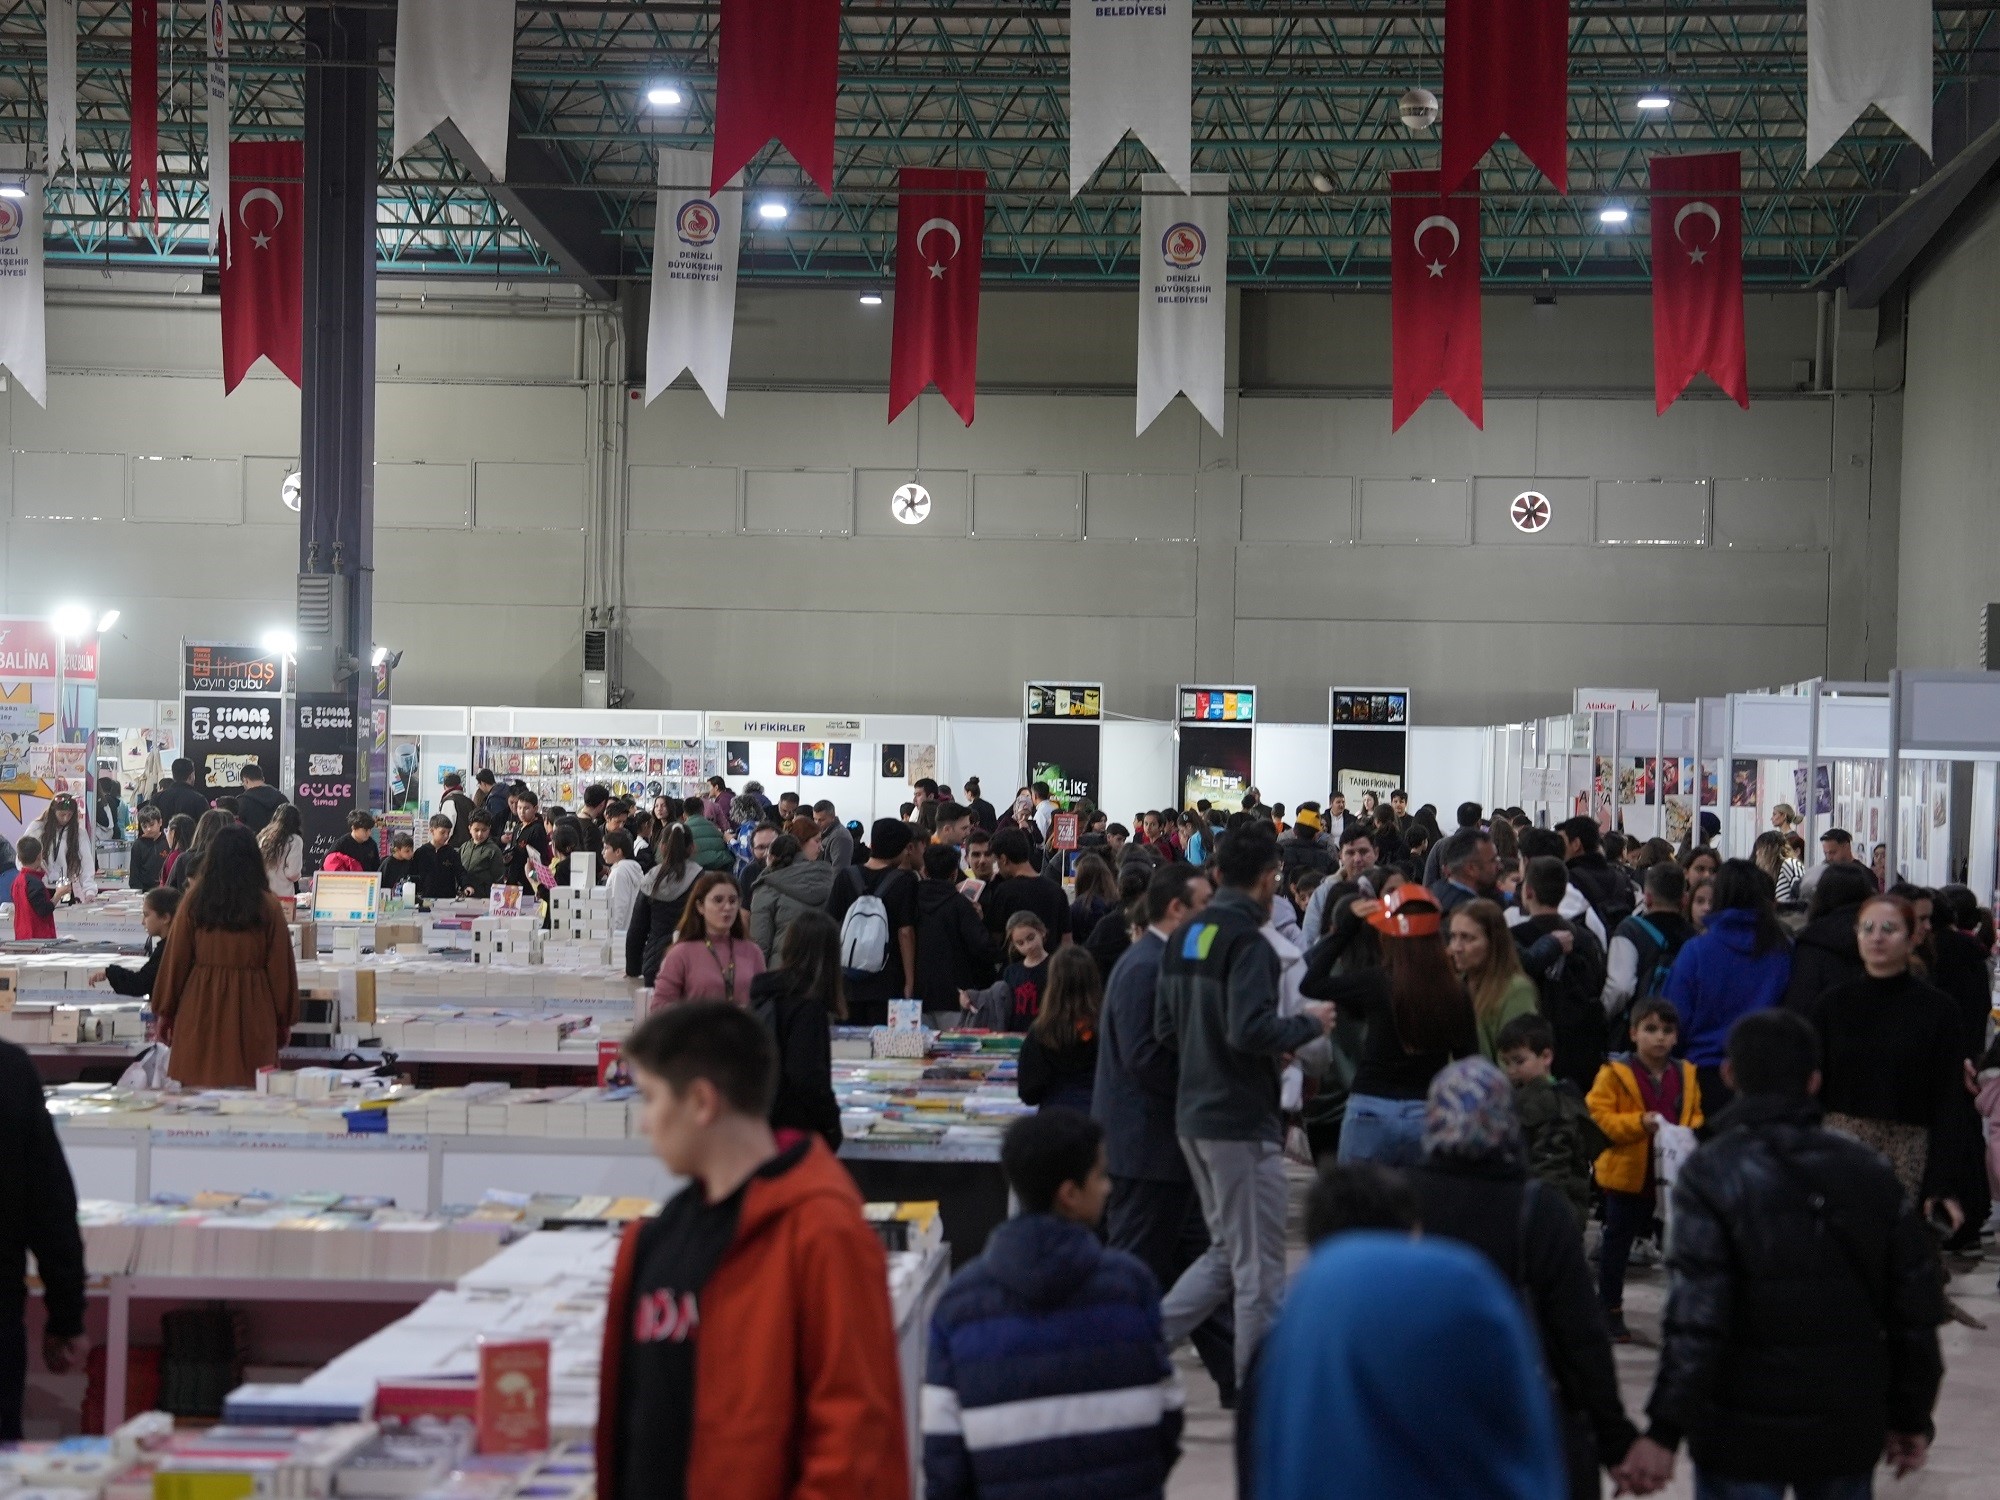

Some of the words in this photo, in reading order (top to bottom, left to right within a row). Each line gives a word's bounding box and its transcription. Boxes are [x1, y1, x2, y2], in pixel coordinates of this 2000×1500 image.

[1095, 4, 1167, 17] BELEDİYESİ
[679, 250, 713, 260] DENİZLİ
[667, 259, 723, 272] BÜYÜKŞEHİR
[670, 271, 719, 281] BELEDİYESİ
[1166, 273, 1201, 283] DENİZLİ
[1154, 284, 1212, 295] BÜYÜKŞEHİR
[1157, 295, 1209, 304] BELEDİYESİ
[216, 656, 275, 685] timaş
[193, 677, 225, 691] yayın
[228, 673, 264, 692] grubu
[313, 717, 353, 730] ÇOCUK
[744, 722, 758, 731] İYİ
[760, 722, 806, 732] FİKİRLER
[212, 725, 274, 742] ÇOCUK
[299, 782, 352, 798] GÜLCE
